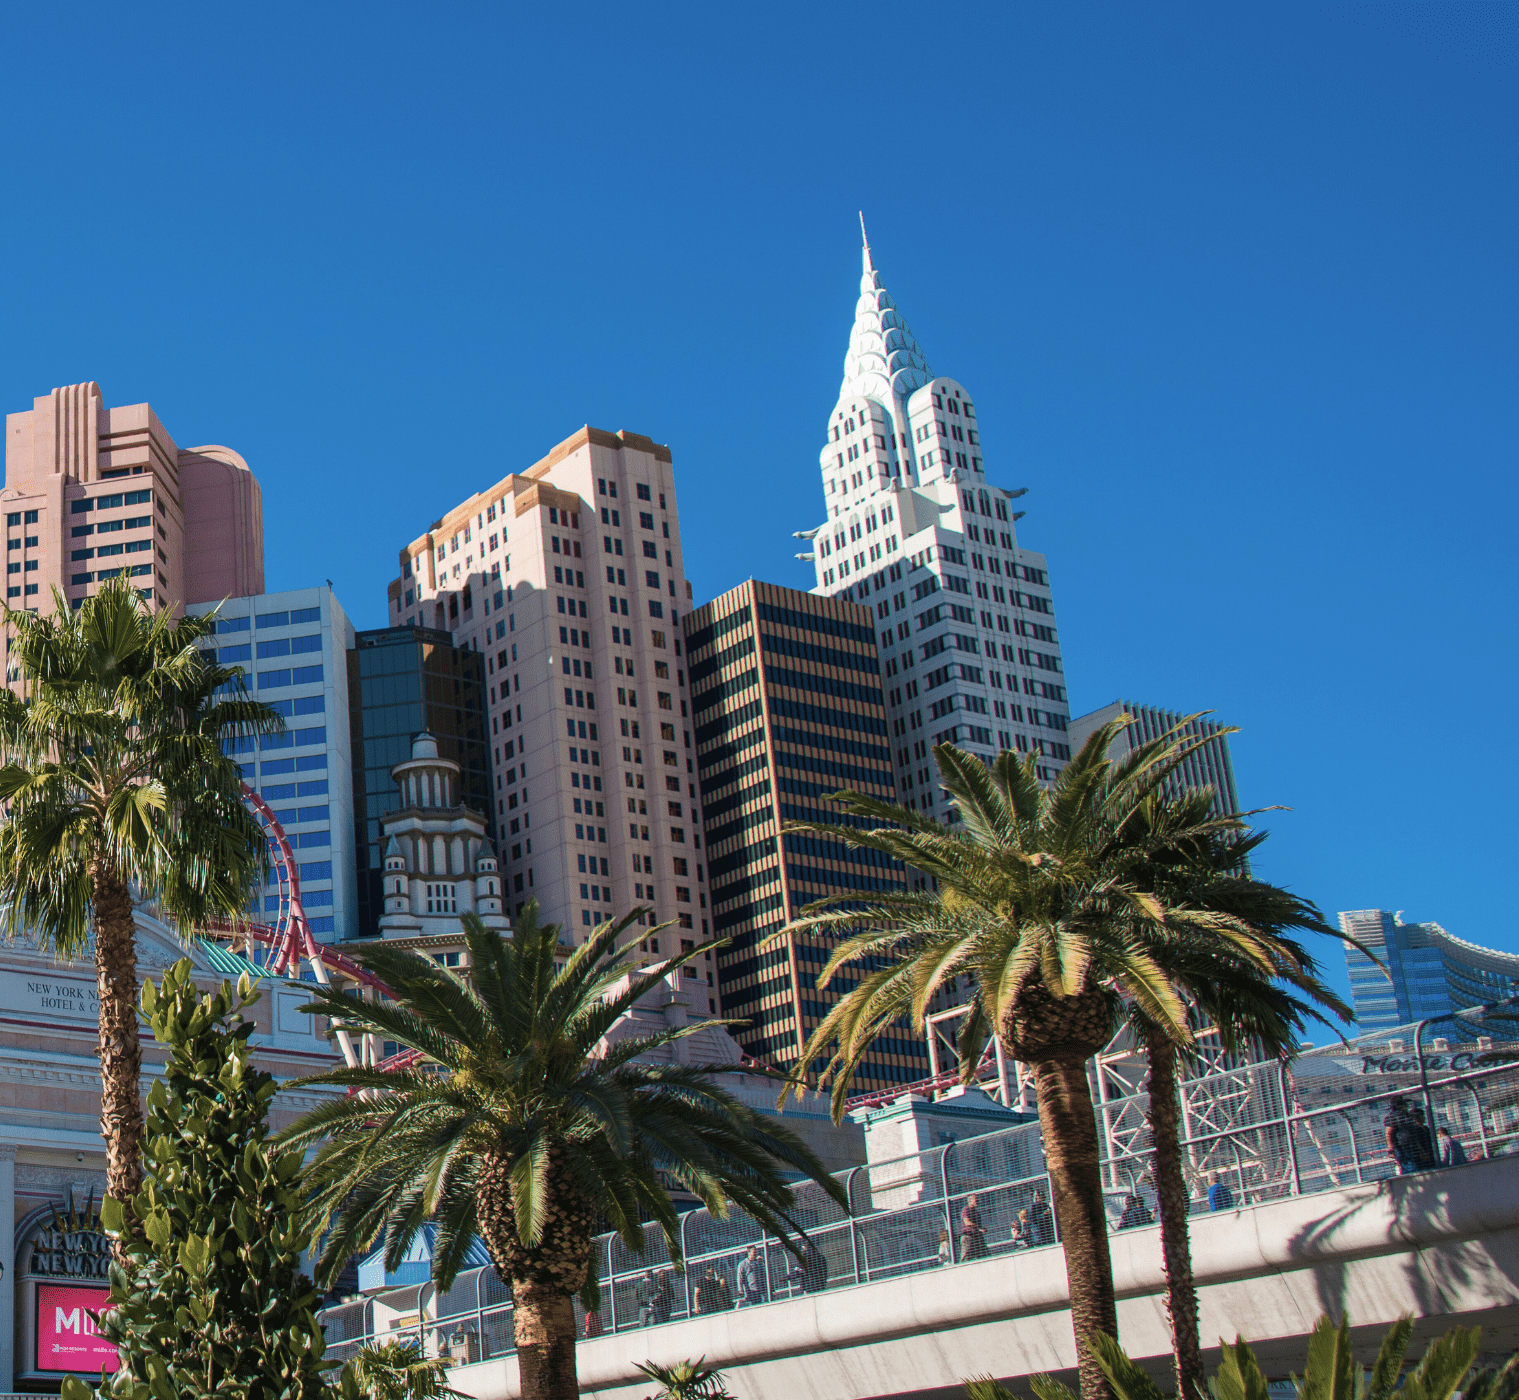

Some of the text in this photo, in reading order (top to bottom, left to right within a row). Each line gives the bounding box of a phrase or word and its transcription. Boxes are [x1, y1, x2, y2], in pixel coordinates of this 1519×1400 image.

[27, 982, 52, 994] NEW
[55, 985, 84, 999] YORK
[41, 996, 75, 1010] HOTEL
[79, 1001, 86, 1012] &
[38, 1231, 112, 1254] NEW YO
[38, 1252, 112, 1275] NEW YO
